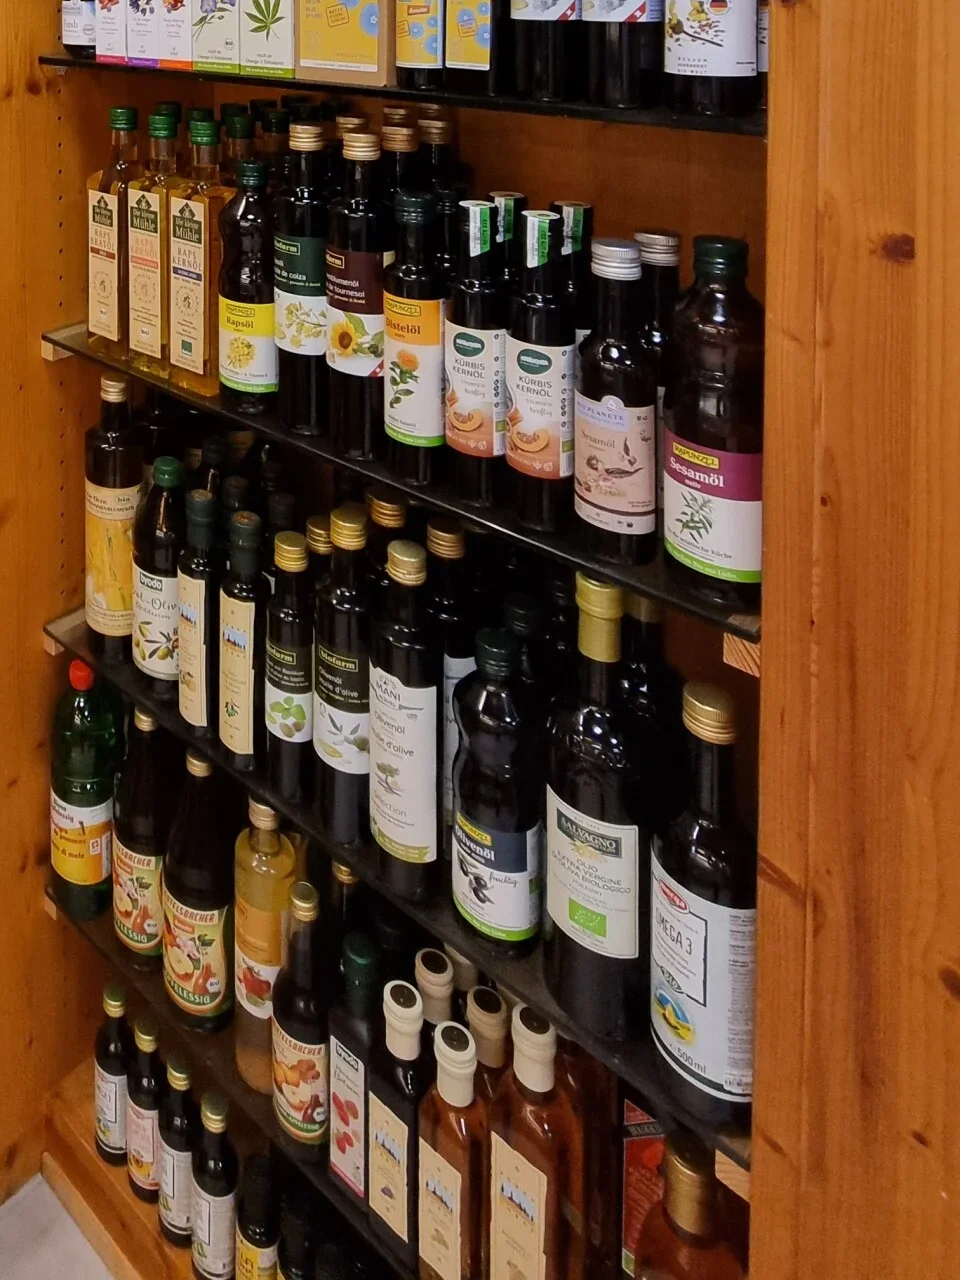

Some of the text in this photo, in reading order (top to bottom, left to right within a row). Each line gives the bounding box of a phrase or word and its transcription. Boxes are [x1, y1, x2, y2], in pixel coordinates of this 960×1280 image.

[133, 218, 156, 233] Mühle
[175, 227, 200, 243] Mühle
[177, 246, 197, 260] RAPS
[172, 255, 202, 271] KERNÖL
[289, 272, 307, 281] colza
[226, 316, 254, 329] Rapsöl
[454, 357, 486, 371] KÜRBIS
[452, 366, 486, 380] KERNÖL
[519, 375, 552, 388] KÜRBIS
[516, 382, 552, 398] KERNÖL
[674, 444, 719, 468] RAPUNZEL
[670, 456, 726, 488] Sesamöl
[141, 576, 162, 590] byodo
[321, 649, 356, 670] biofarm
[376, 681, 401, 703] MANI
[386, 739, 415, 758] d'olive
[561, 816, 616, 850] SALVAGNO
[455, 824, 496, 861] Olivenöl
[489, 870, 519, 888] fruchtig
[582, 875, 631, 895] BIOLOGICO
[585, 868, 623, 886] VERGINE
